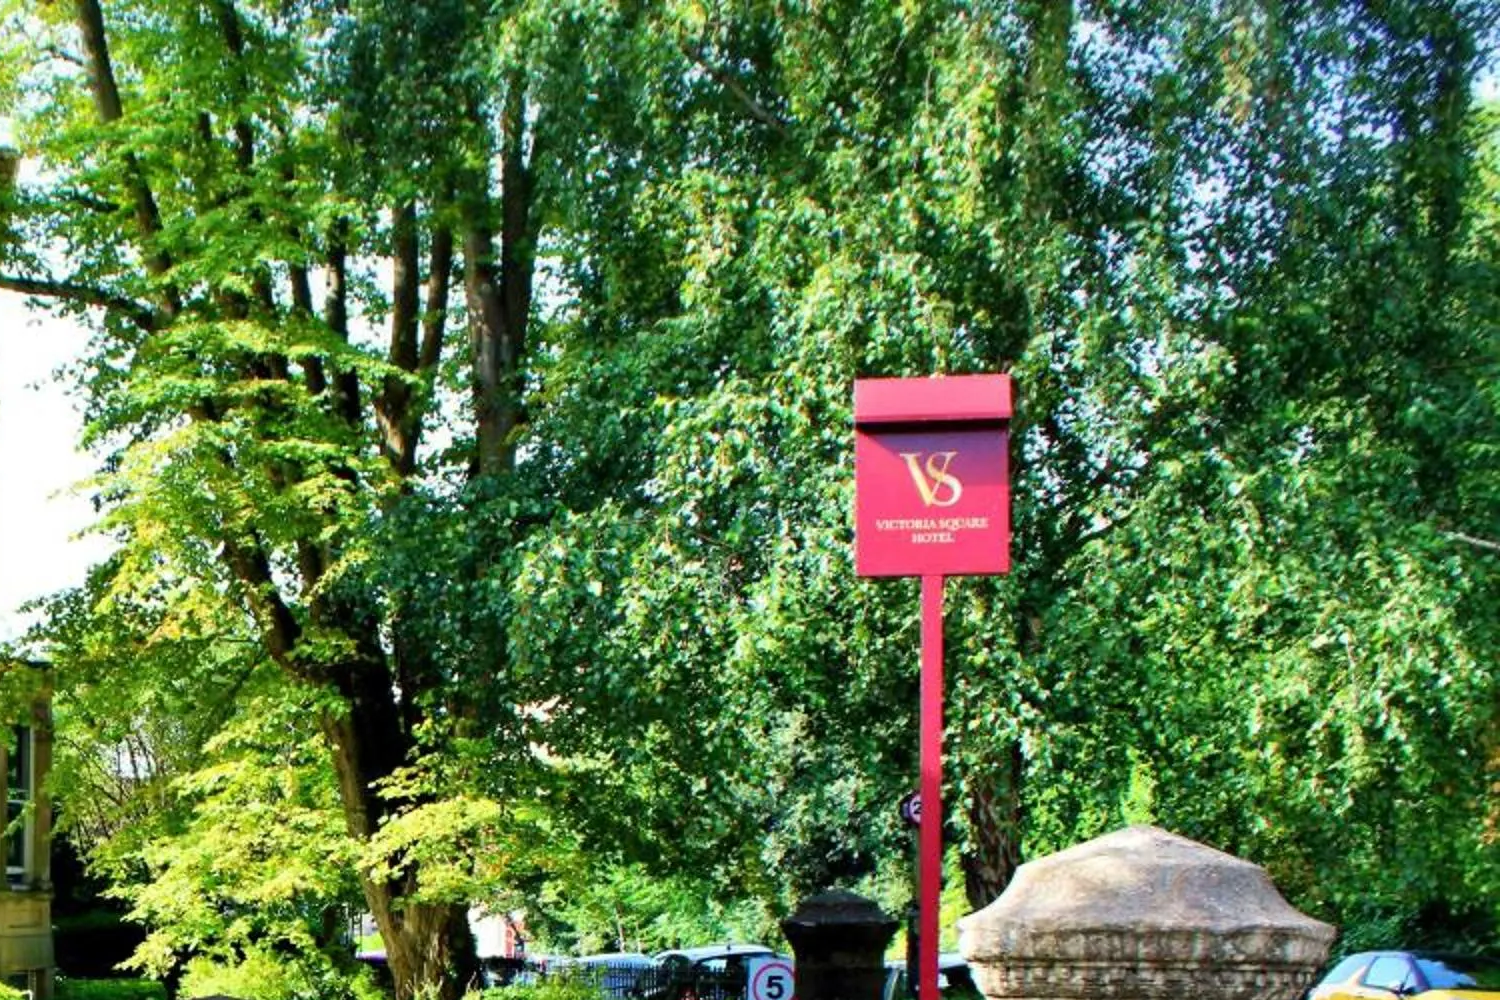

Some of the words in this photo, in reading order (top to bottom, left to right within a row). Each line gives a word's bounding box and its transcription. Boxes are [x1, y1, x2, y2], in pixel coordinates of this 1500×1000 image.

[900, 451, 962, 507] VS
[875, 519, 937, 531] VICTORIA
[939, 517, 989, 531] SQUARE
[912, 532, 955, 544] HOTEL
[766, 975, 784, 1000] 5
